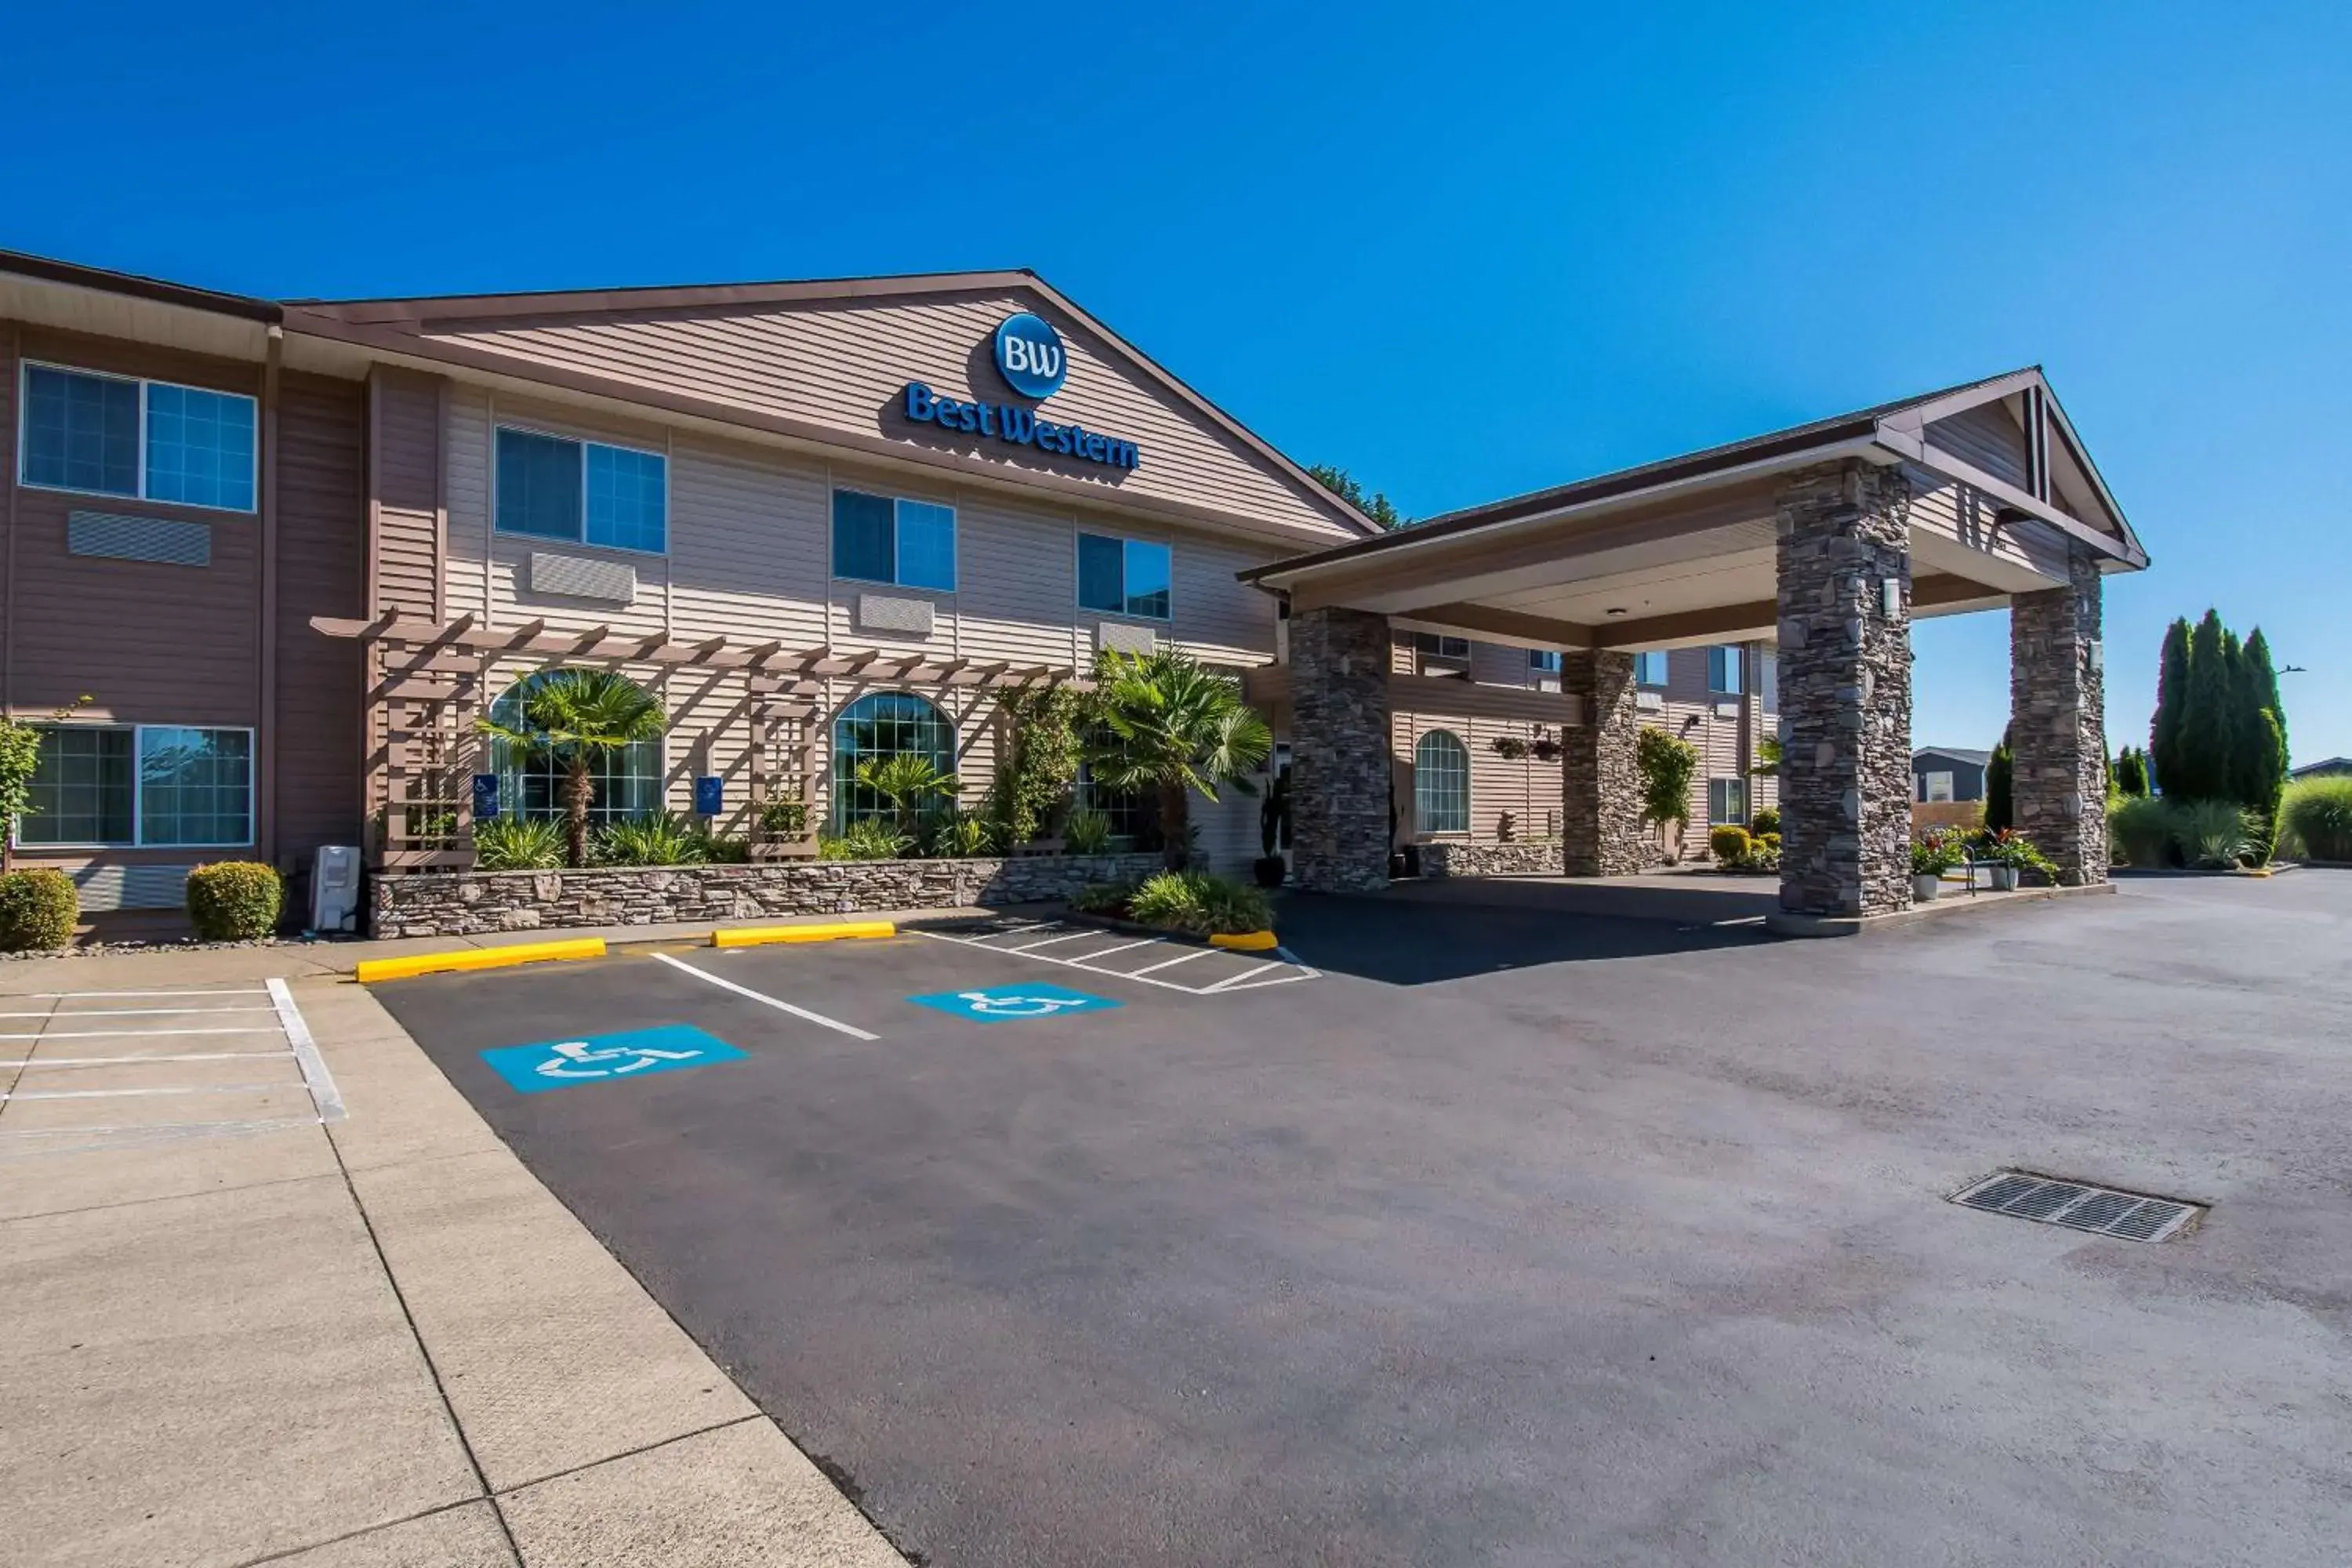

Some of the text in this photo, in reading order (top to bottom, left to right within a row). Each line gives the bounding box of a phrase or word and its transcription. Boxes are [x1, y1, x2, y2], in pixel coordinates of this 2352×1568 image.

[1004, 336, 1060, 378] BW
[905, 381, 1140, 469] Best Western
